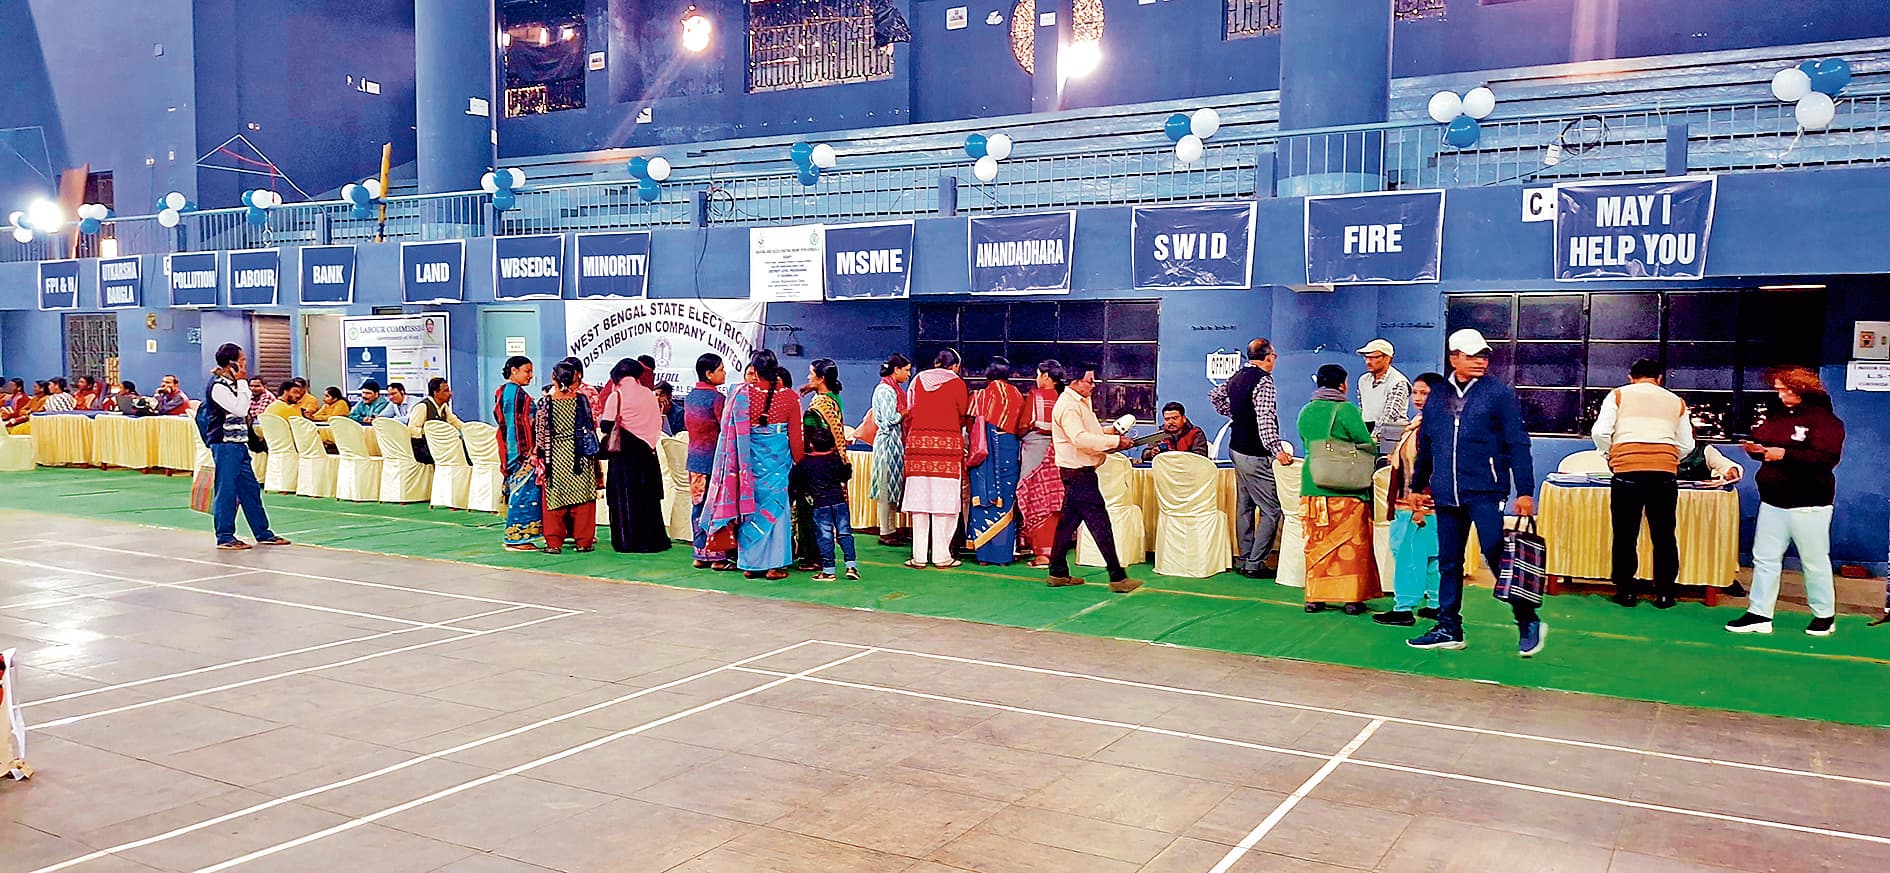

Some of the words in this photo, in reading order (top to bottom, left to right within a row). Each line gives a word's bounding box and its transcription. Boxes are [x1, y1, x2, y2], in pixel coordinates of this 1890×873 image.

[1596, 195, 1656, 227] MAY
[1662, 194, 1671, 225] I
[1153, 232, 1228, 261] SWID
[1343, 223, 1403, 254] FIRE
[976, 239, 1064, 268] ANANDADHARA
[1570, 235, 1635, 267] HELP
[1642, 233, 1696, 265] YOU
[102, 262, 137, 281] UTKARSHA
[415, 262, 449, 283] LAND
[501, 256, 559, 278] WBSEDCL
[583, 254, 645, 277] MINORITY
[836, 249, 903, 275] MSME
[46, 277, 58, 293] FPI
[60, 276, 67, 292] &
[173, 270, 216, 289] POLLUTION
[234, 269, 275, 288] LABOUR
[312, 265, 345, 284] BANK
[107, 285, 134, 304] BANGLA
[570, 323, 600, 355] WEST
[603, 304, 646, 331] BENGAL
[650, 302, 684, 317] STATE
[688, 306, 752, 359] ELECTRICITY
[583, 321, 652, 368] DISTRIBUTION
[655, 321, 705, 341] COMPANY
[707, 334, 742, 373] LIMITED
[1211, 357, 1238, 375] OFFICIAL
